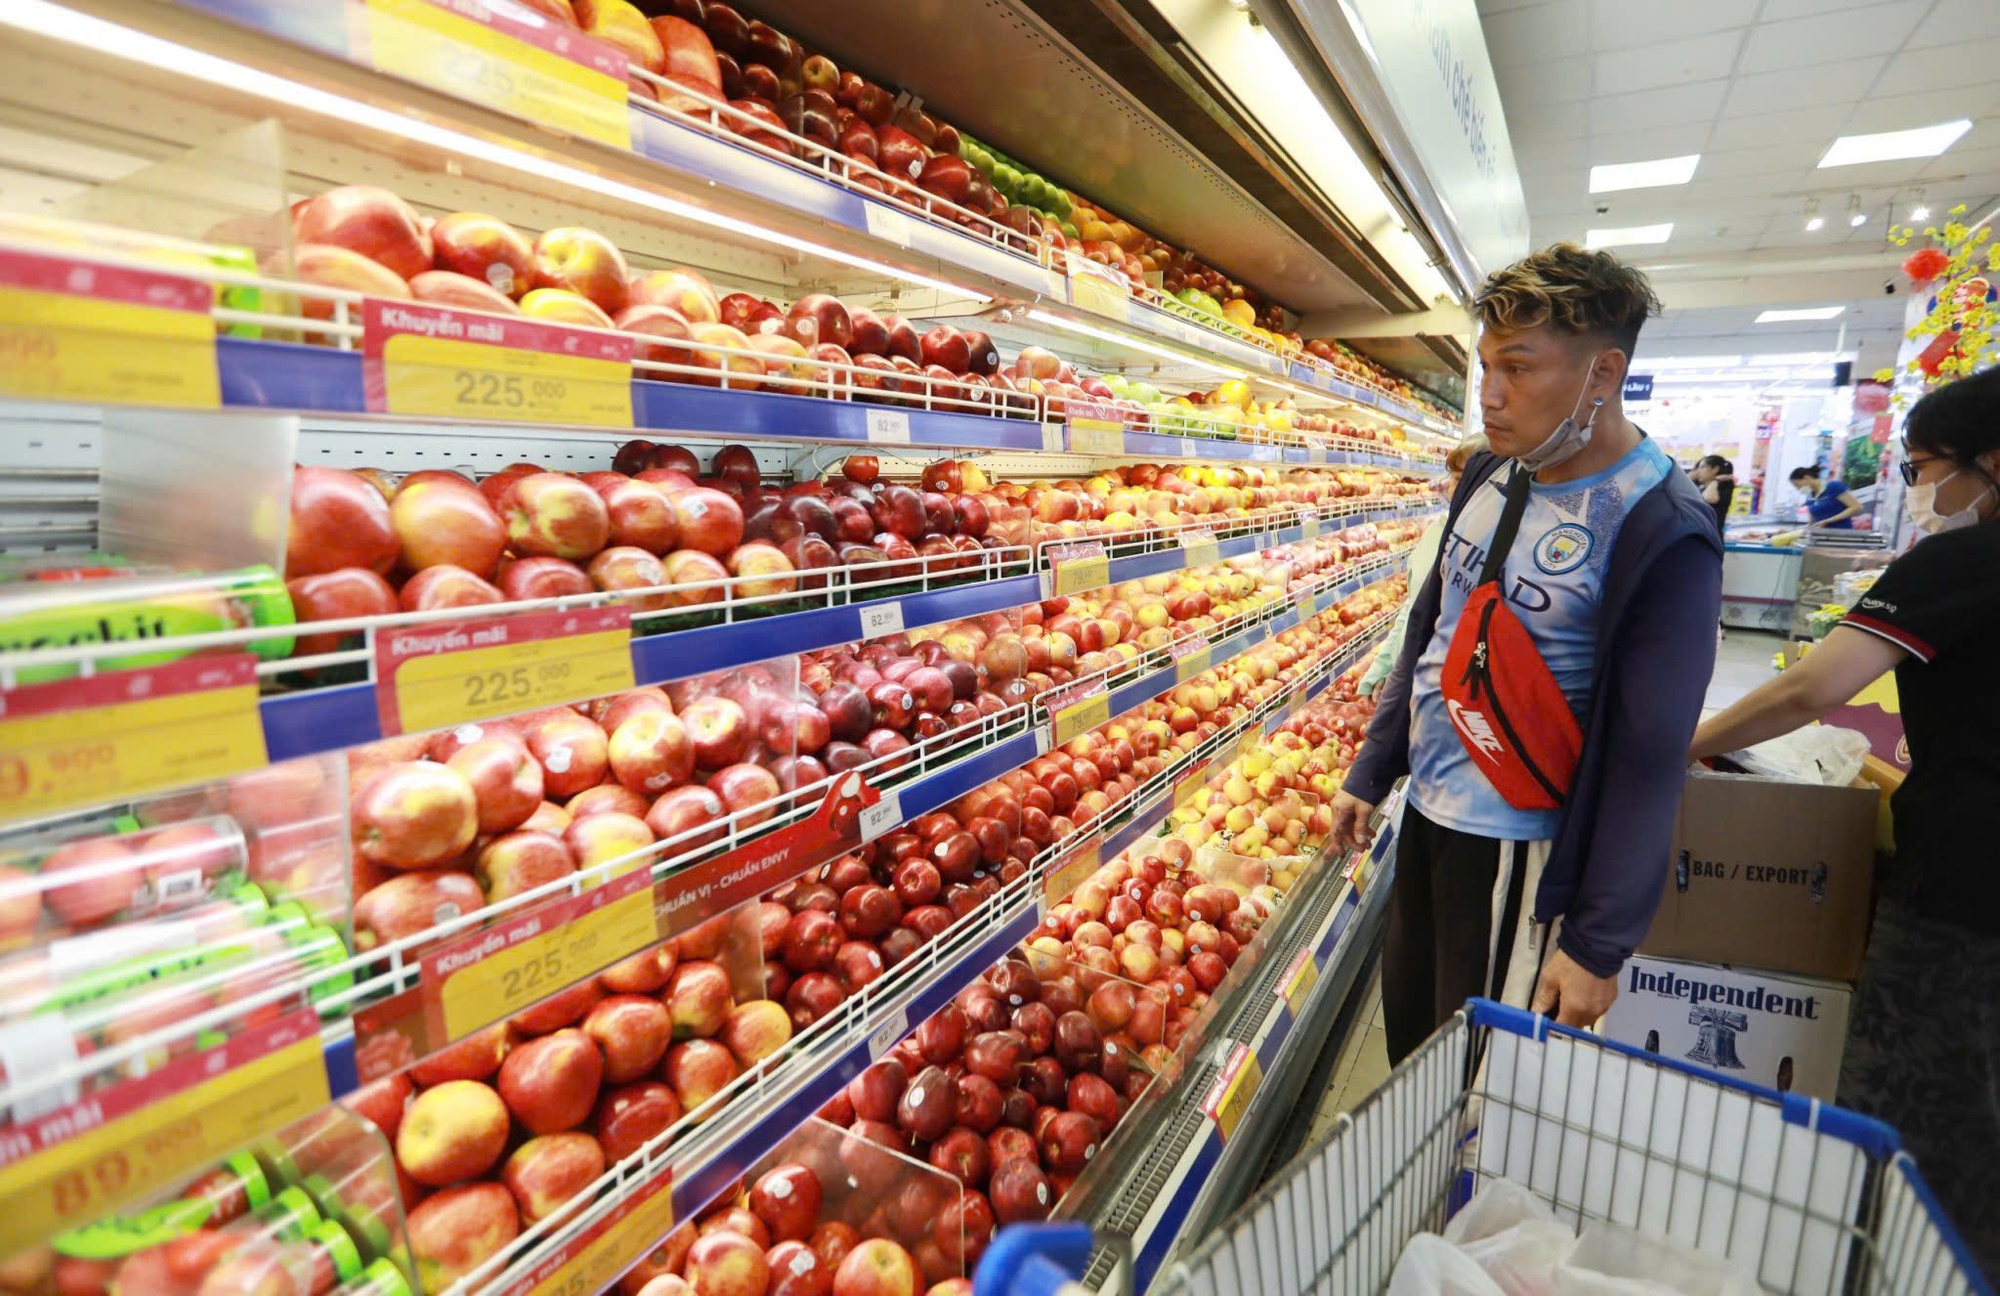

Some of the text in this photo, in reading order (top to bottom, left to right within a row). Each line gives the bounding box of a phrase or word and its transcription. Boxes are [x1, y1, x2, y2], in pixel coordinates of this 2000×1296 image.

[1551, 529, 1587, 551] MANCHESTER
[1443, 528, 1552, 612] TIHD
[1542, 560, 1558, 570] CITY
[1441, 562, 1478, 597] AIRW
[760, 847, 790, 870] ENVY
[1693, 860, 1811, 885] BAG / EXPORT
[1629, 965, 1822, 1020] Independent
